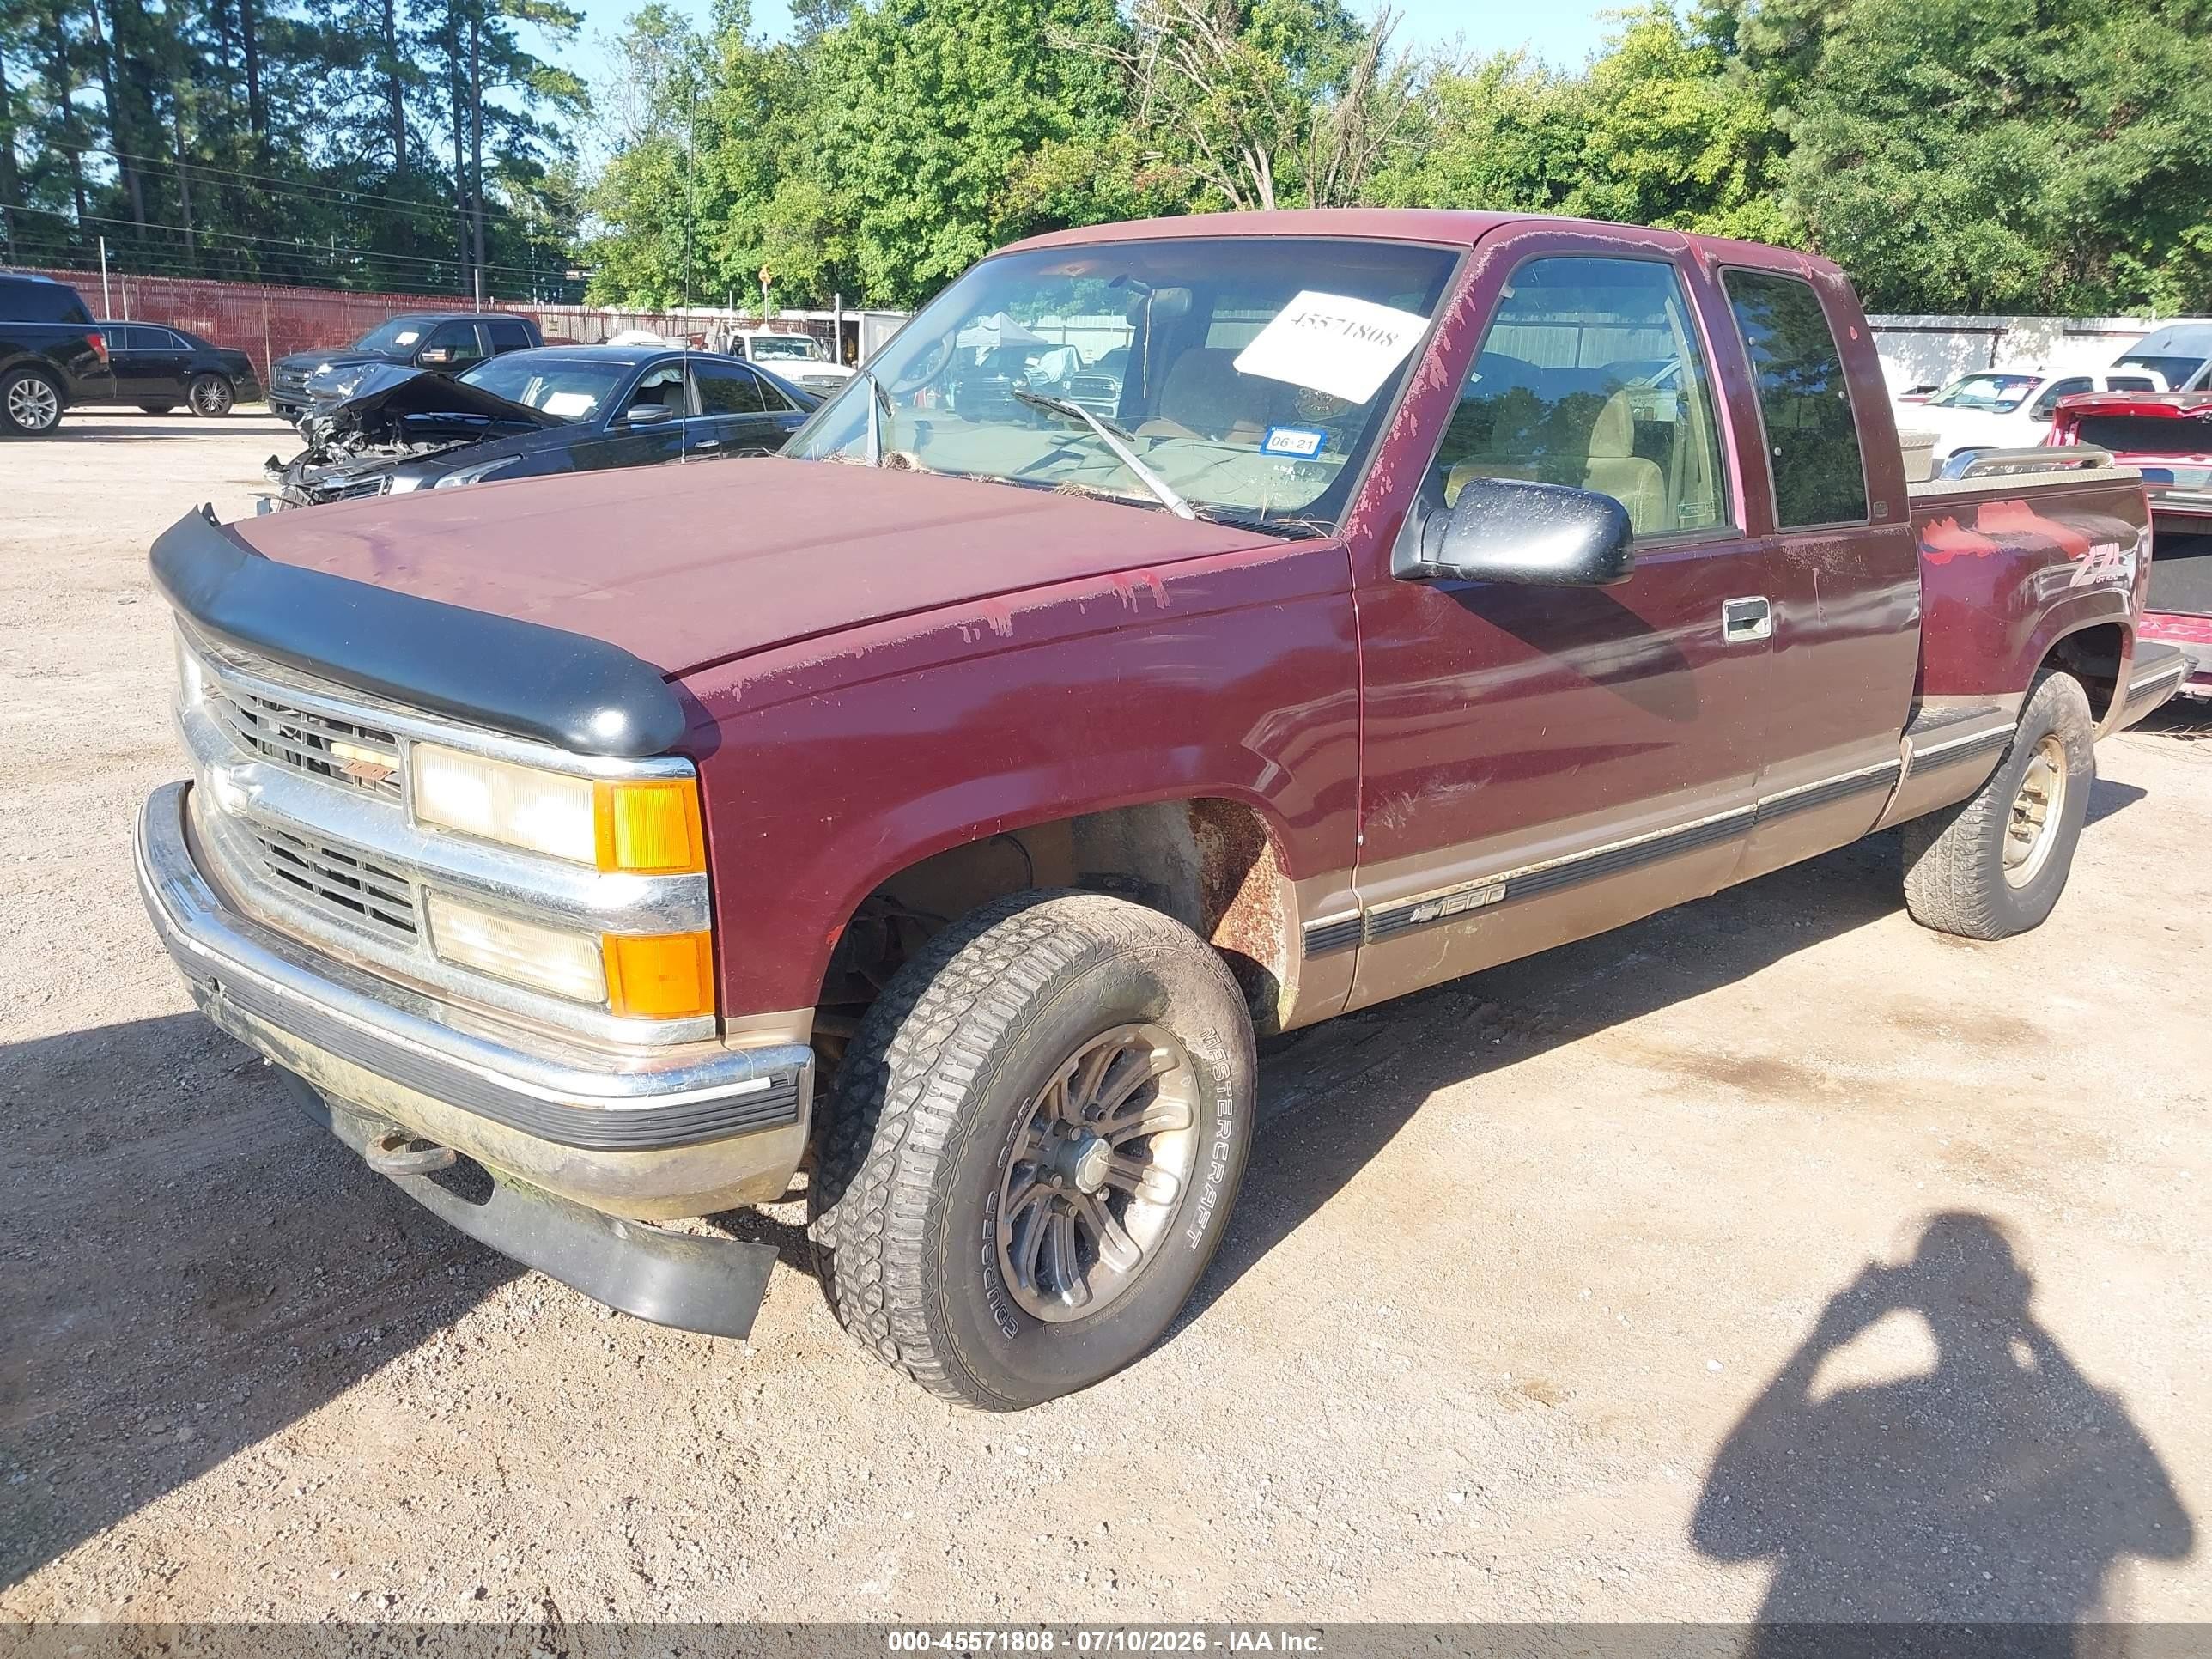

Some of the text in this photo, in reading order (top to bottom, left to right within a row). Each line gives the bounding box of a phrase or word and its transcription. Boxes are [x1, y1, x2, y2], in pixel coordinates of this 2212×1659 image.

[1291, 313, 1399, 347] 45571808
[1439, 884, 1506, 917] 1500
[1186, 1026, 1233, 1250] MASTERCRAFT
[981, 1097, 1031, 1340] COURSER STR
